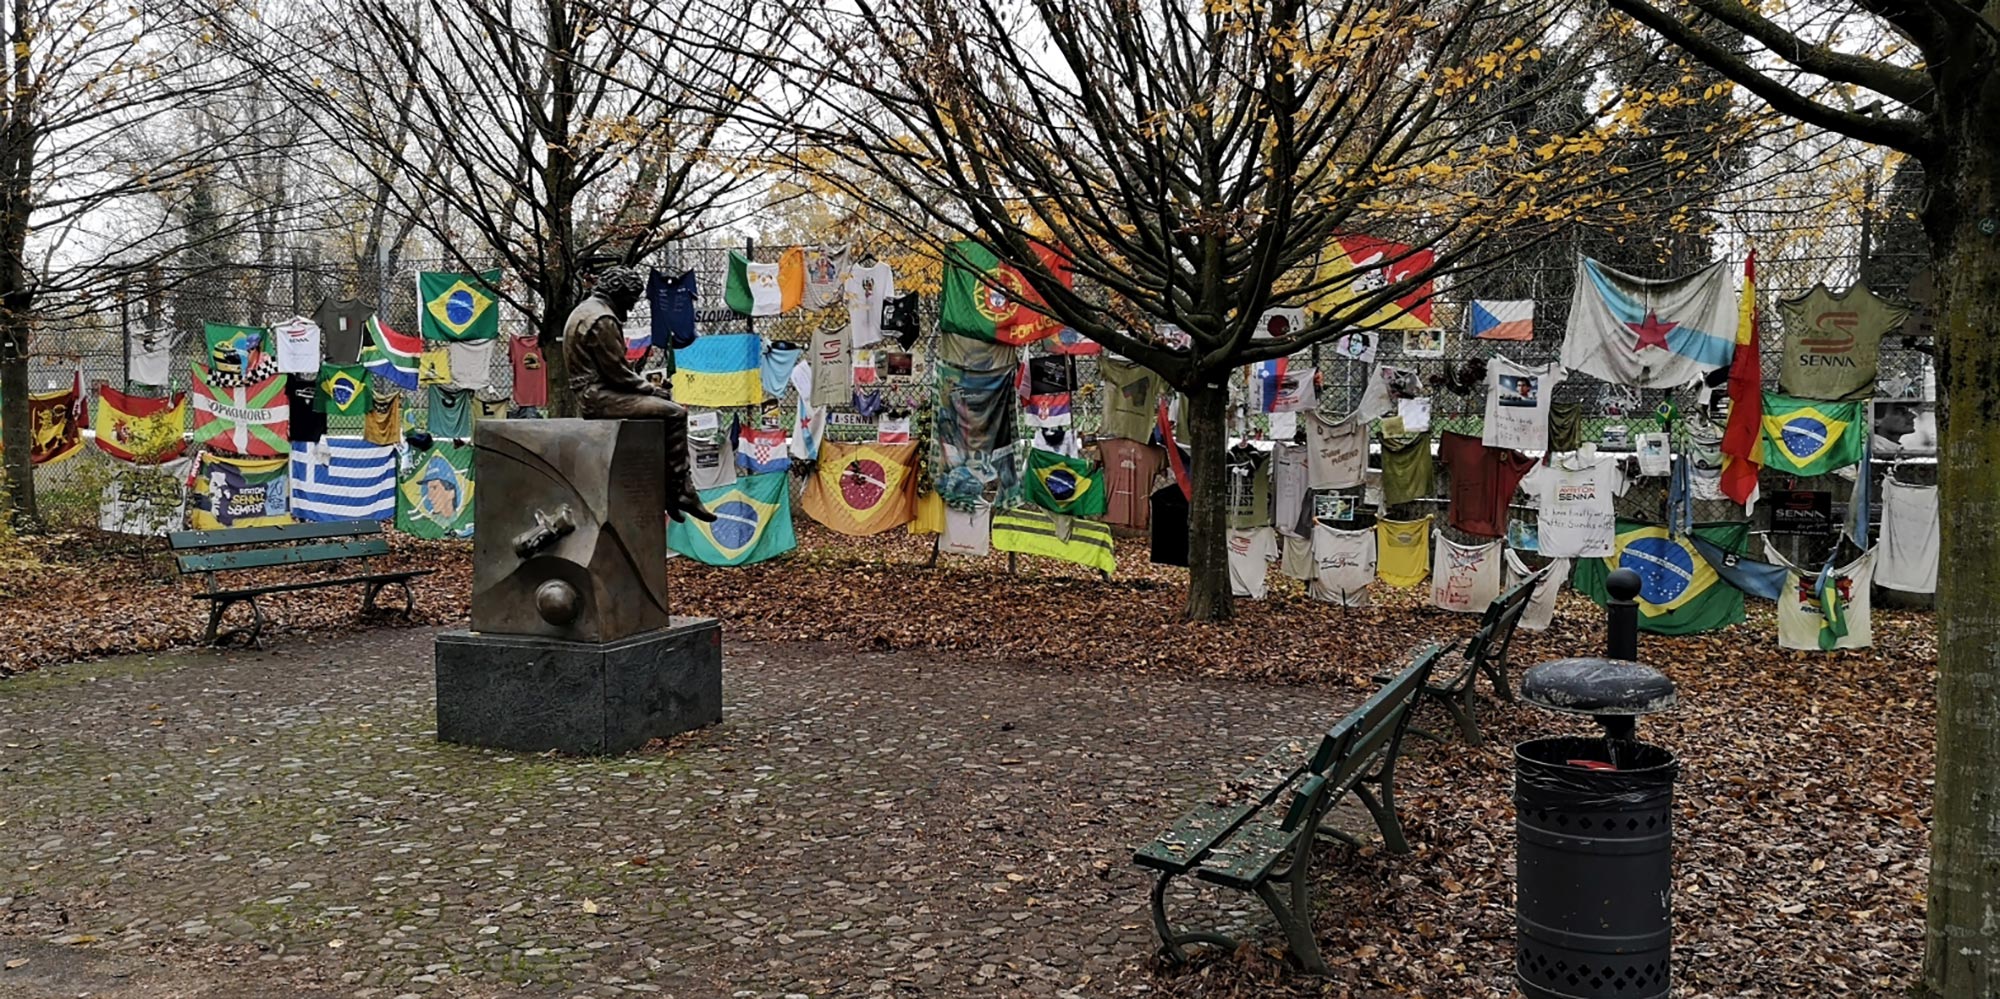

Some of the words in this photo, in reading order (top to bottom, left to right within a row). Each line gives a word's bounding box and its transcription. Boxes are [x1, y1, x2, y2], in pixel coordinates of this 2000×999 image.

[1800, 353, 1857, 368] SENNA
[1558, 493, 1596, 501] SENNA
[1775, 508, 1826, 519] SENNA
